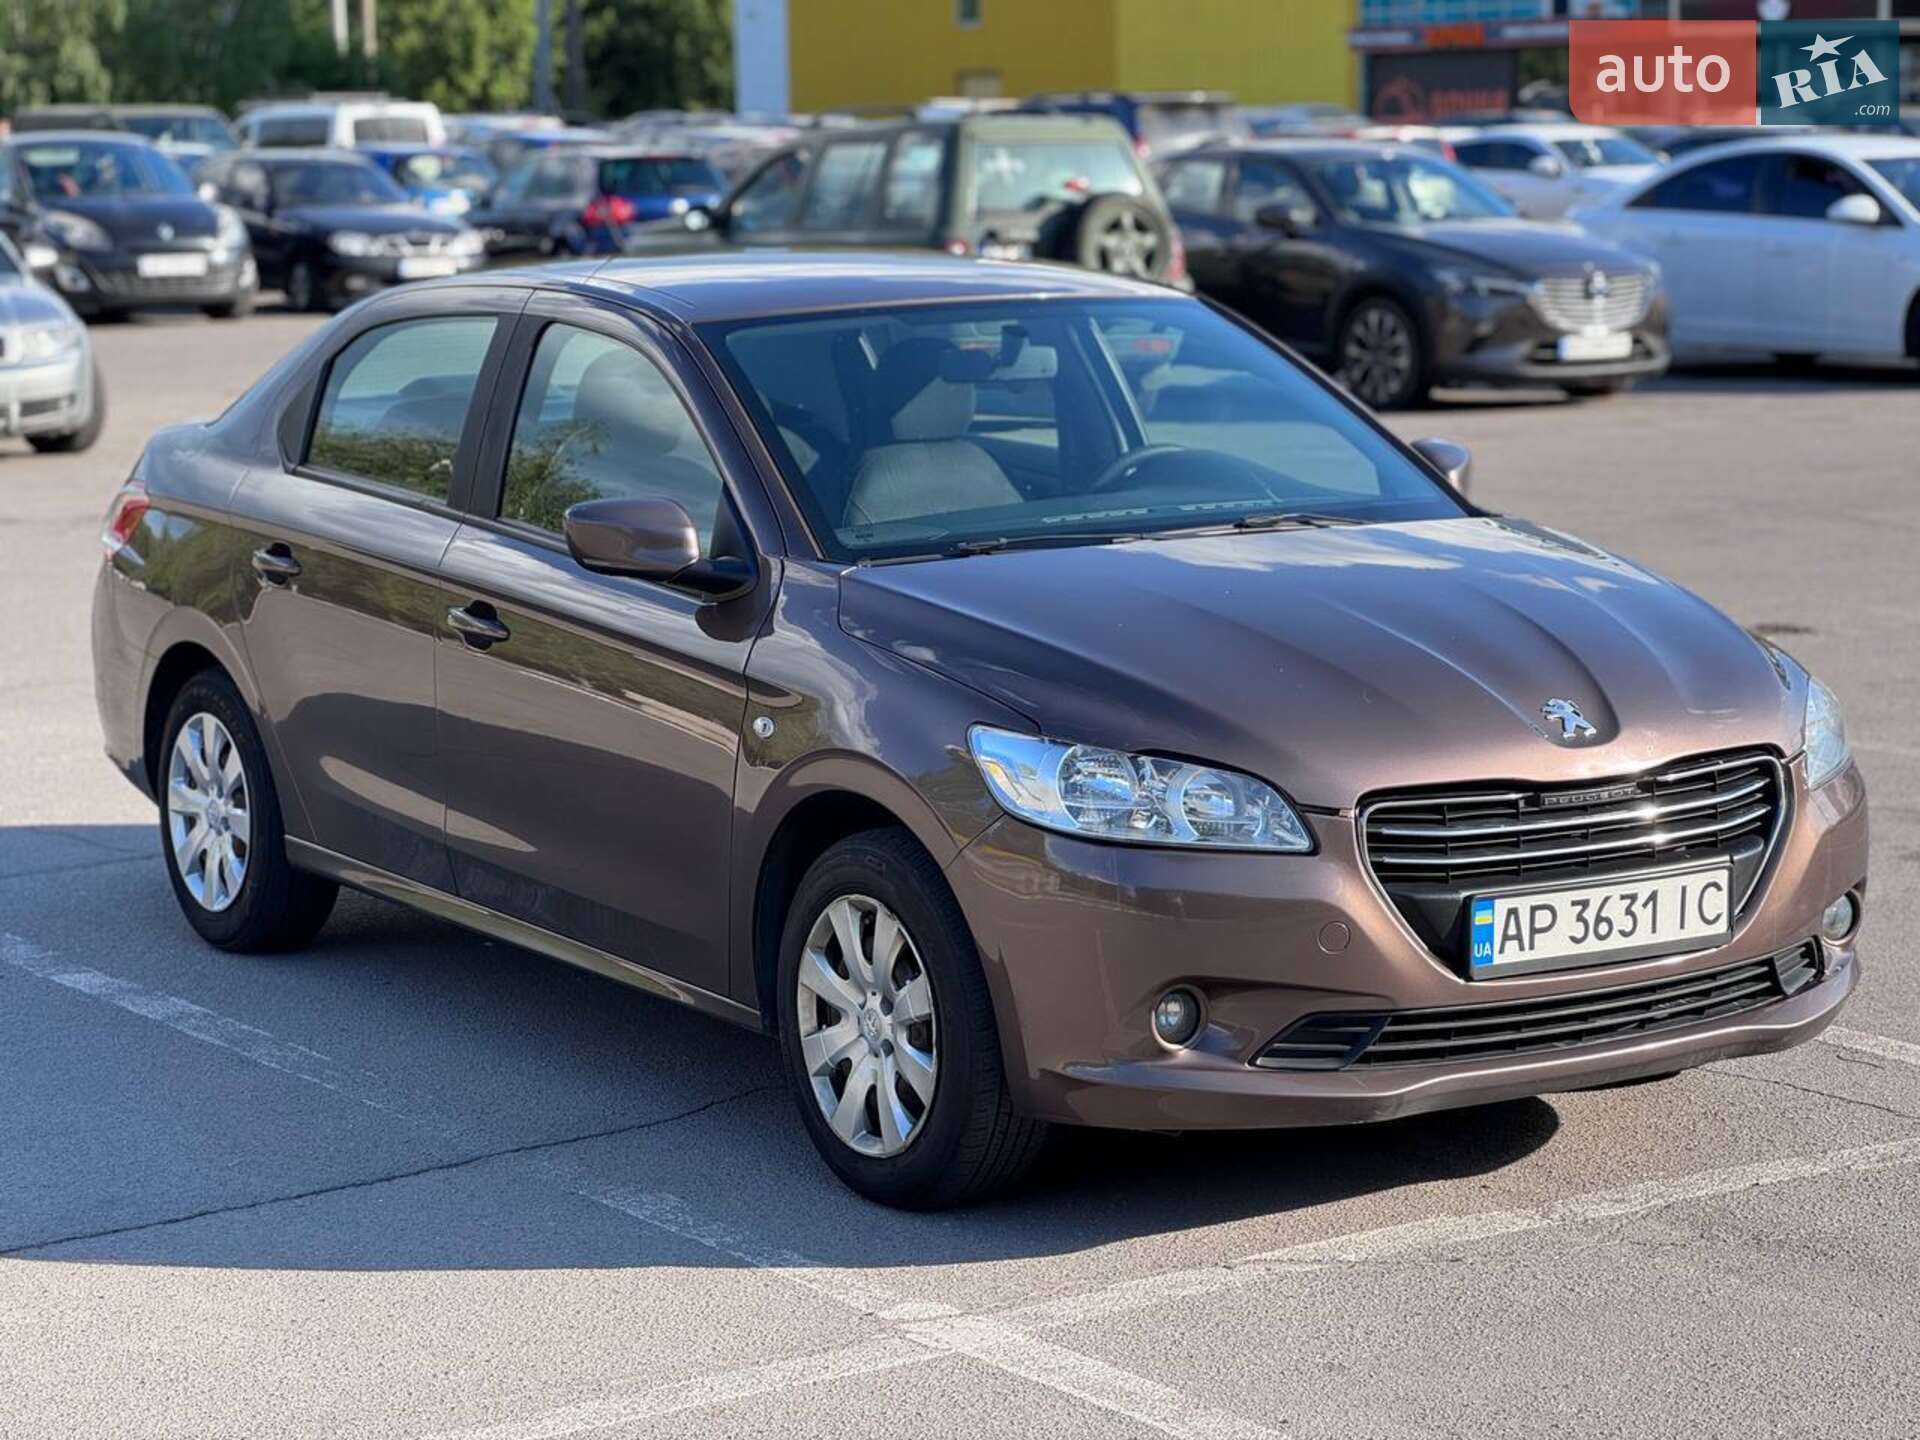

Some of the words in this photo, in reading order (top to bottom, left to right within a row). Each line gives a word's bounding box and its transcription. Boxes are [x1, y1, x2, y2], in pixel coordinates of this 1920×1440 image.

[1498, 903, 1558, 955] AP
[1568, 889, 1659, 945] 3631
[1679, 880, 1724, 931] IC
[1474, 942, 1493, 958] UA
